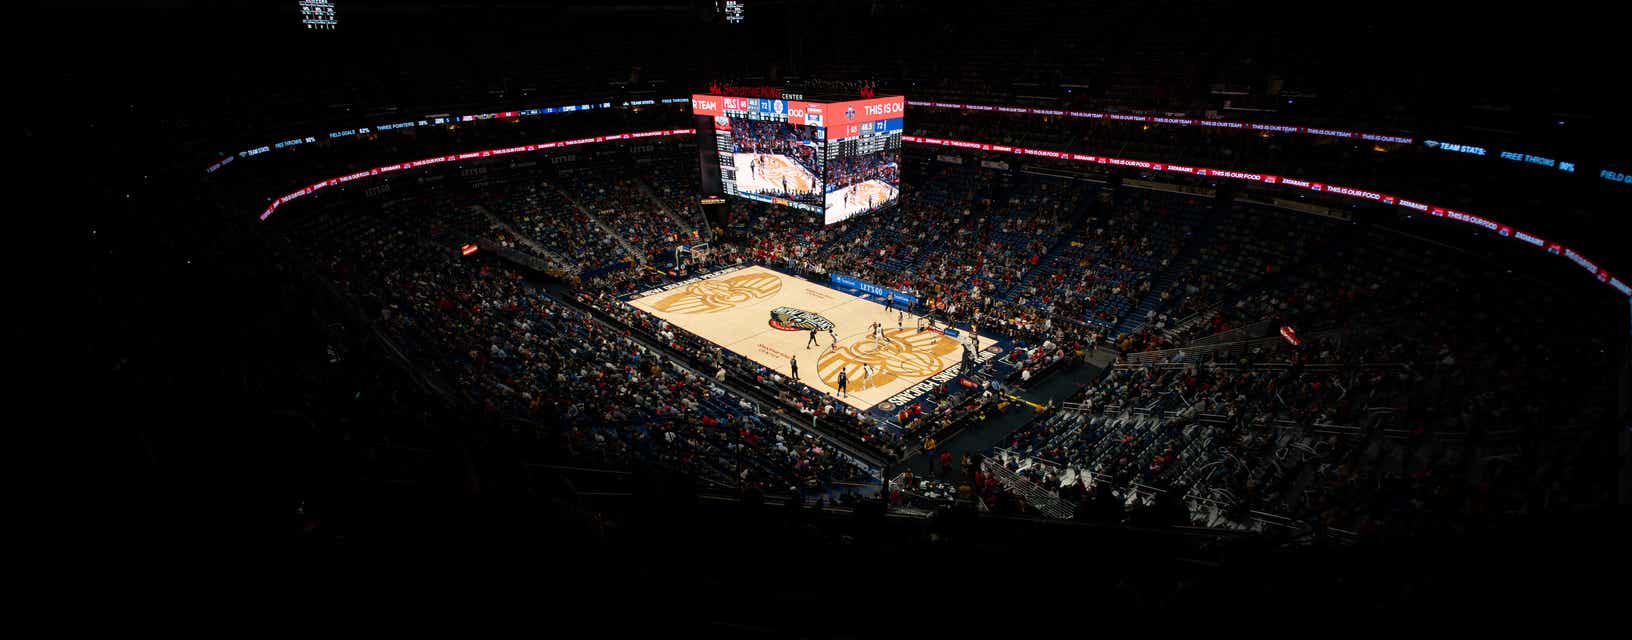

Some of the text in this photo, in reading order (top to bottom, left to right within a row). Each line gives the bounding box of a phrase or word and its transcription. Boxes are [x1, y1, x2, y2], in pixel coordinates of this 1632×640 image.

[699, 101, 717, 110] TEAM
[864, 105, 882, 116] THIS
[883, 103, 891, 113] IS
[892, 102, 904, 112] OU
[1440, 142, 1460, 151] TEAM
[1501, 151, 1524, 161] FREE
[1525, 154, 1555, 167] THROWS
[1600, 169, 1624, 182] FIELD
